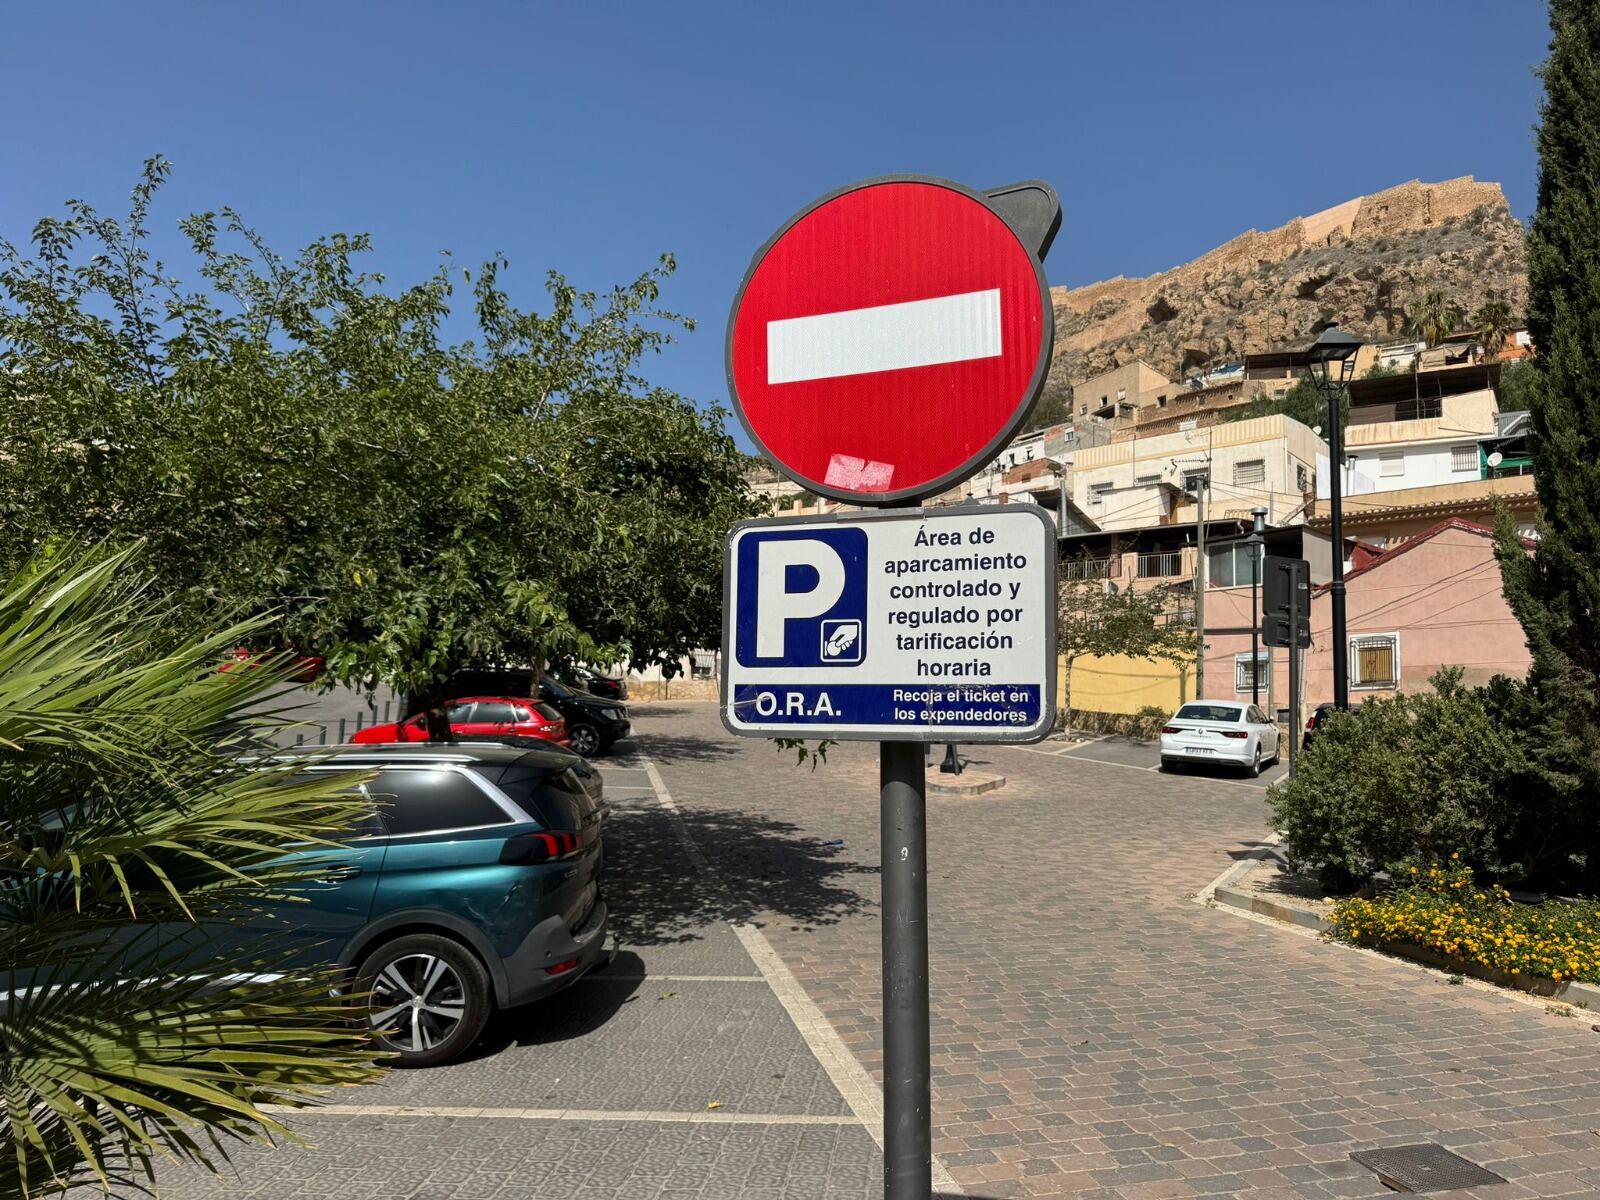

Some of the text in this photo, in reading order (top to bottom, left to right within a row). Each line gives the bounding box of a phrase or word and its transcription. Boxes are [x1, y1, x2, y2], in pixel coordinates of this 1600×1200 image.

[914, 525, 994, 546] Área de
[885, 553, 1026, 576] aparcamiento
[757, 540, 846, 659] P
[890, 580, 1020, 600] controlado y
[889, 606, 1022, 628] regulado por
[896, 631, 1012, 650] tarificación
[918, 659, 991, 676] horaria
[755, 692, 841, 715] O.R.A.
[894, 689, 1028, 704] Recoja el ticket en
[895, 708, 1026, 723] los expendedores
